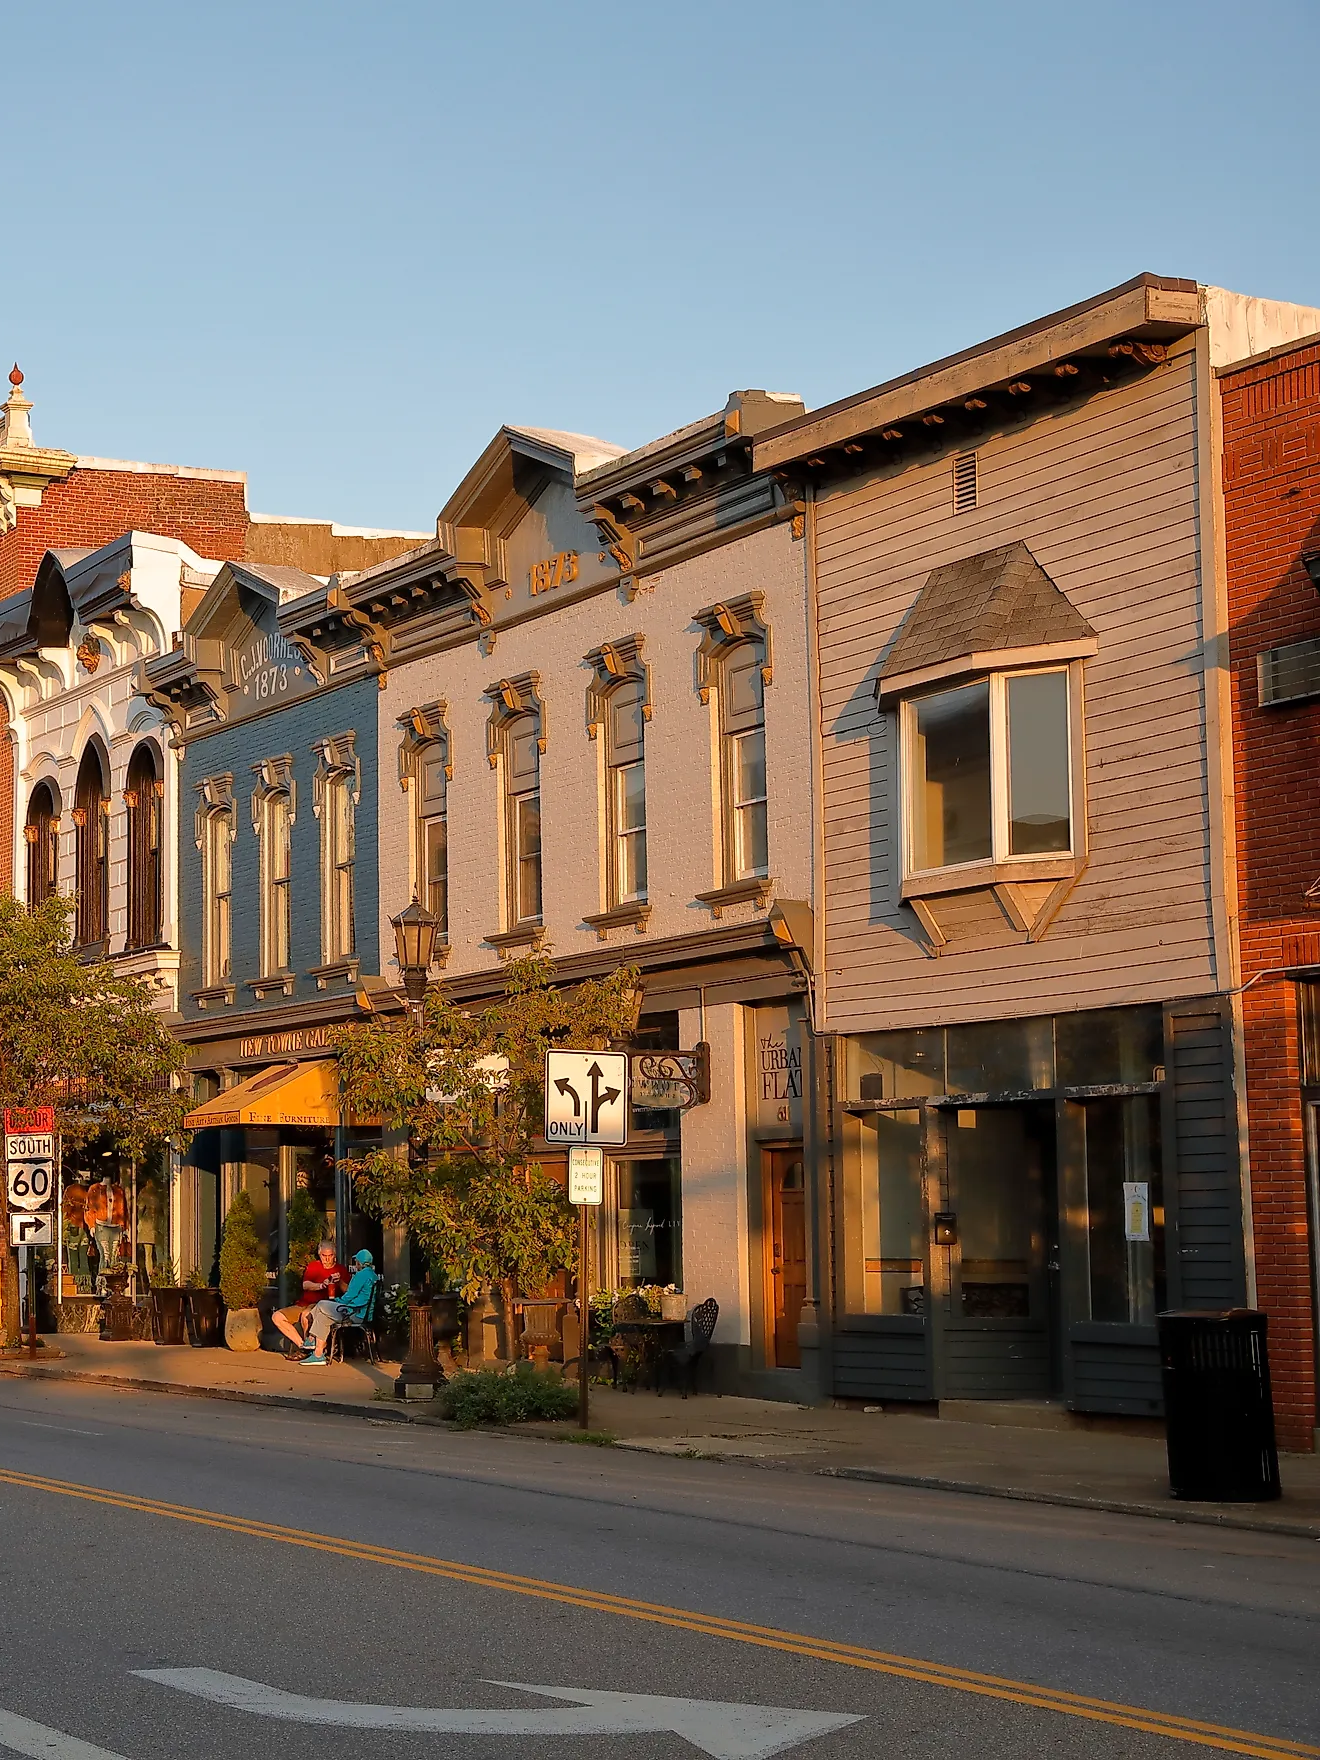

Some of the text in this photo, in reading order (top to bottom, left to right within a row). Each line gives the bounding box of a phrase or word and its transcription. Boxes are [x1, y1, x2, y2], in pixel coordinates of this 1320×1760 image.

[254, 663, 288, 701] 1873
[9, 1110, 48, 1128] DOUR
[248, 1111, 331, 1124] FINE FURNITURE
[549, 1121, 584, 1136] ONLY
[9, 1138, 51, 1155] SOUTH
[572, 1158, 599, 1167] CONSECUTIVE
[12, 1168, 49, 1197] 60
[574, 1184, 597, 1193] PARKING
